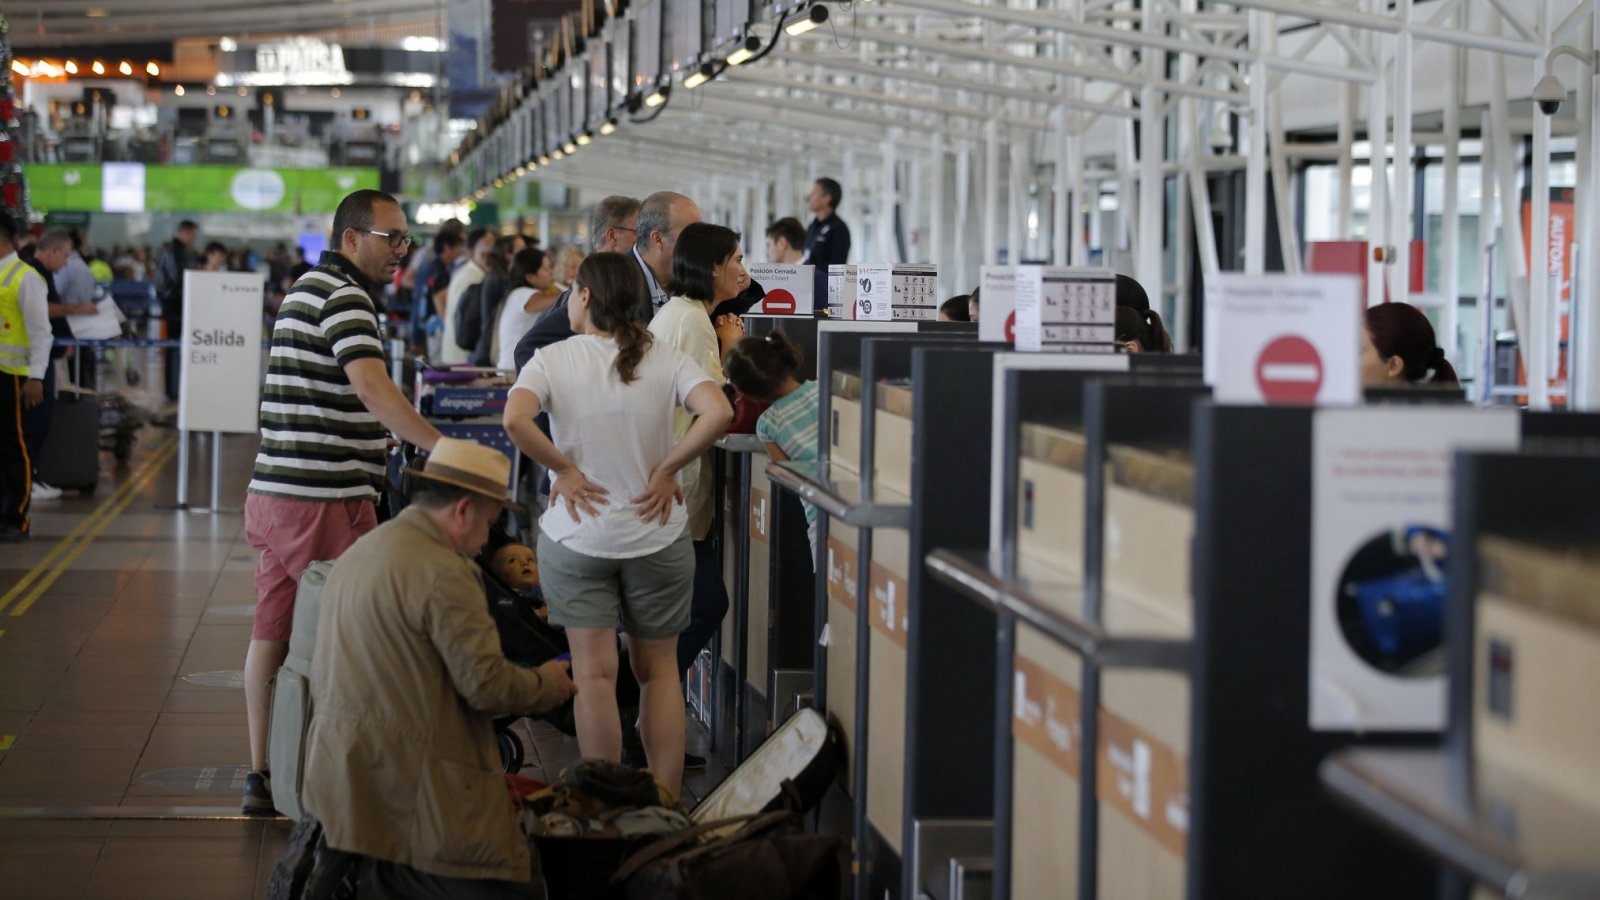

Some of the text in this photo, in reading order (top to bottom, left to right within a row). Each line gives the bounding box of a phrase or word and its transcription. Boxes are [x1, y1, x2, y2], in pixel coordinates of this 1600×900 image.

[192, 328, 245, 347] Salida
[191, 350, 218, 365] Exit
[440, 396, 486, 411] despegar
